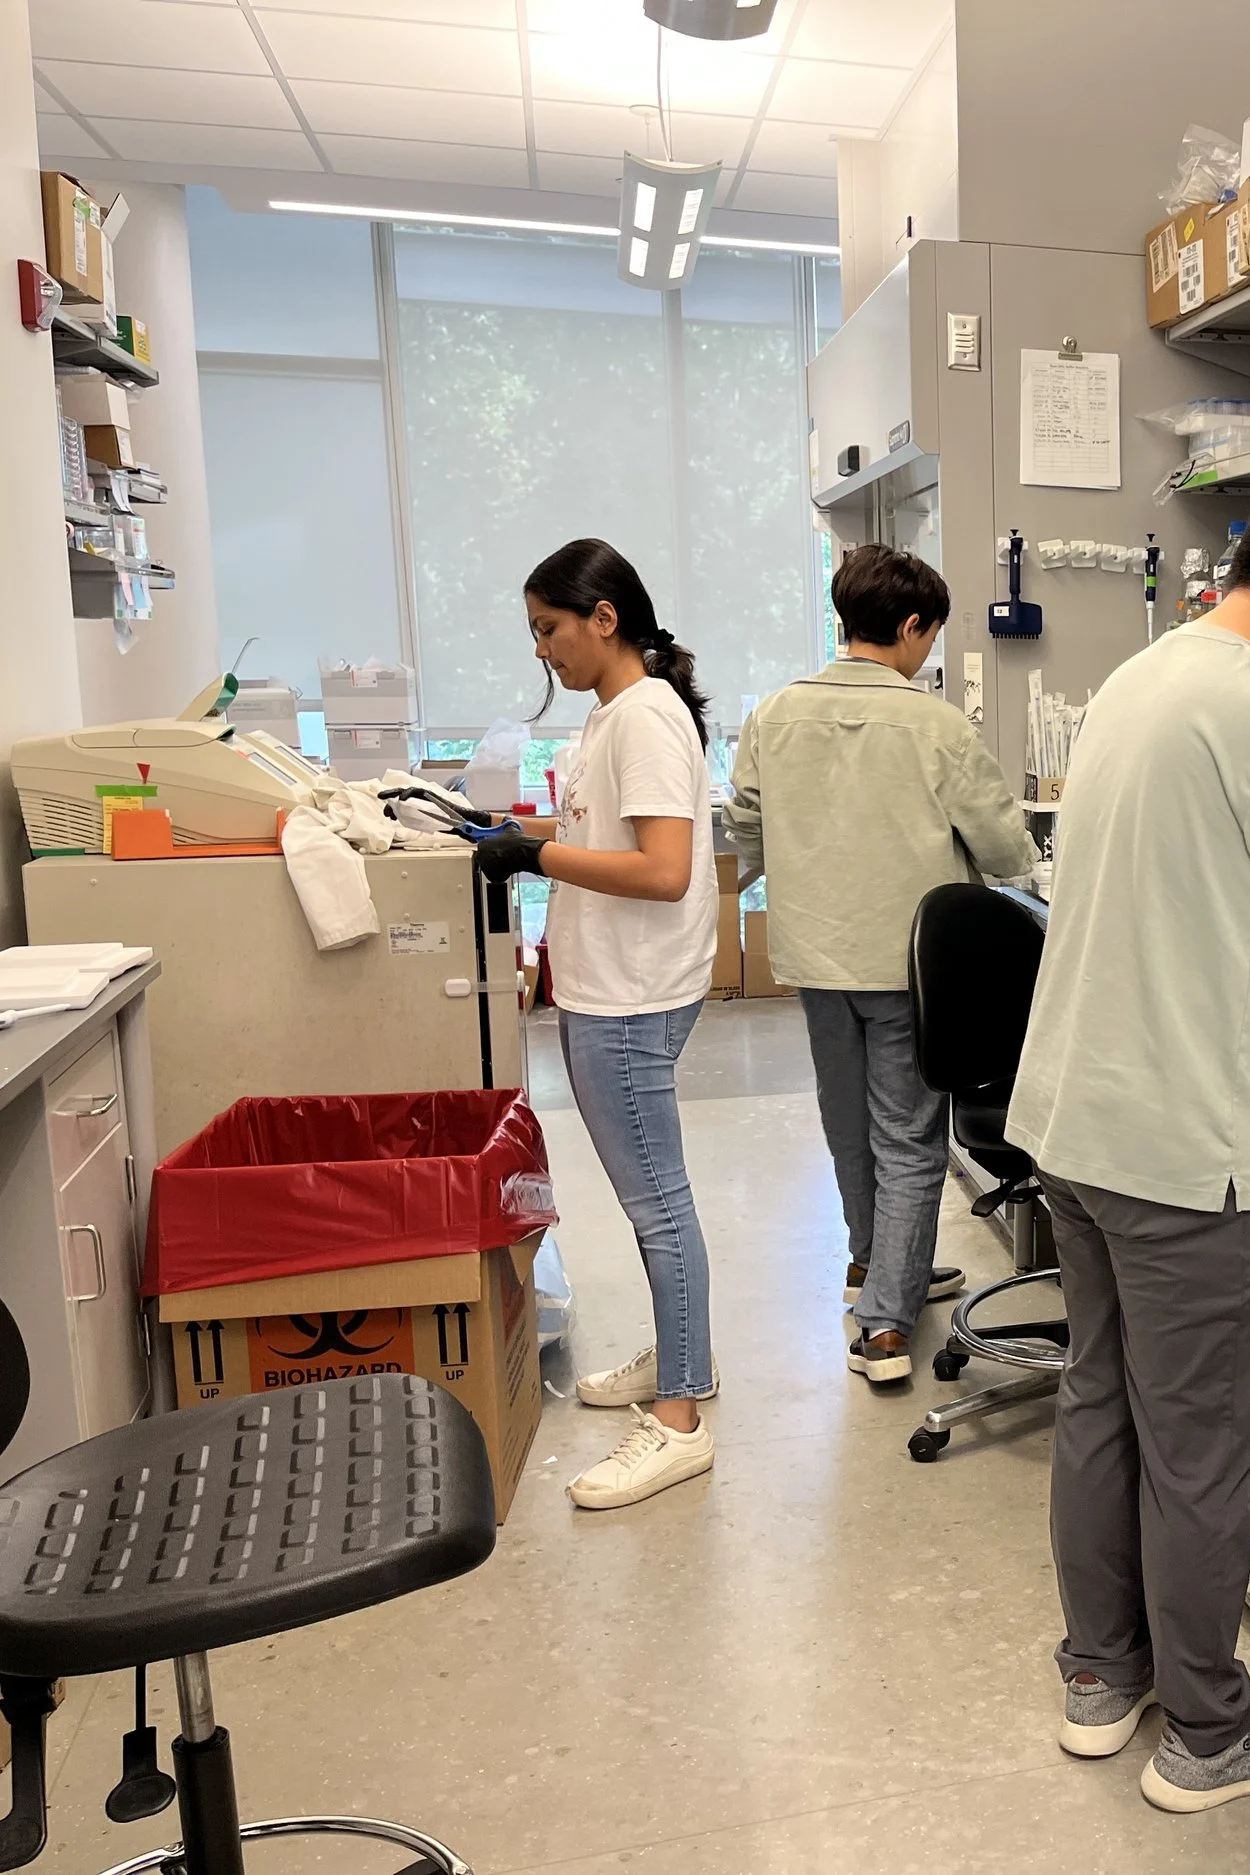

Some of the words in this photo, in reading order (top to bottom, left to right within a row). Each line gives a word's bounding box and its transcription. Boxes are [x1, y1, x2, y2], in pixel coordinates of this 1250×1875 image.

[264, 1362, 402, 1388] BIOHAZARD
[446, 1369, 465, 1381] UP
[200, 1388, 220, 1399] UP
